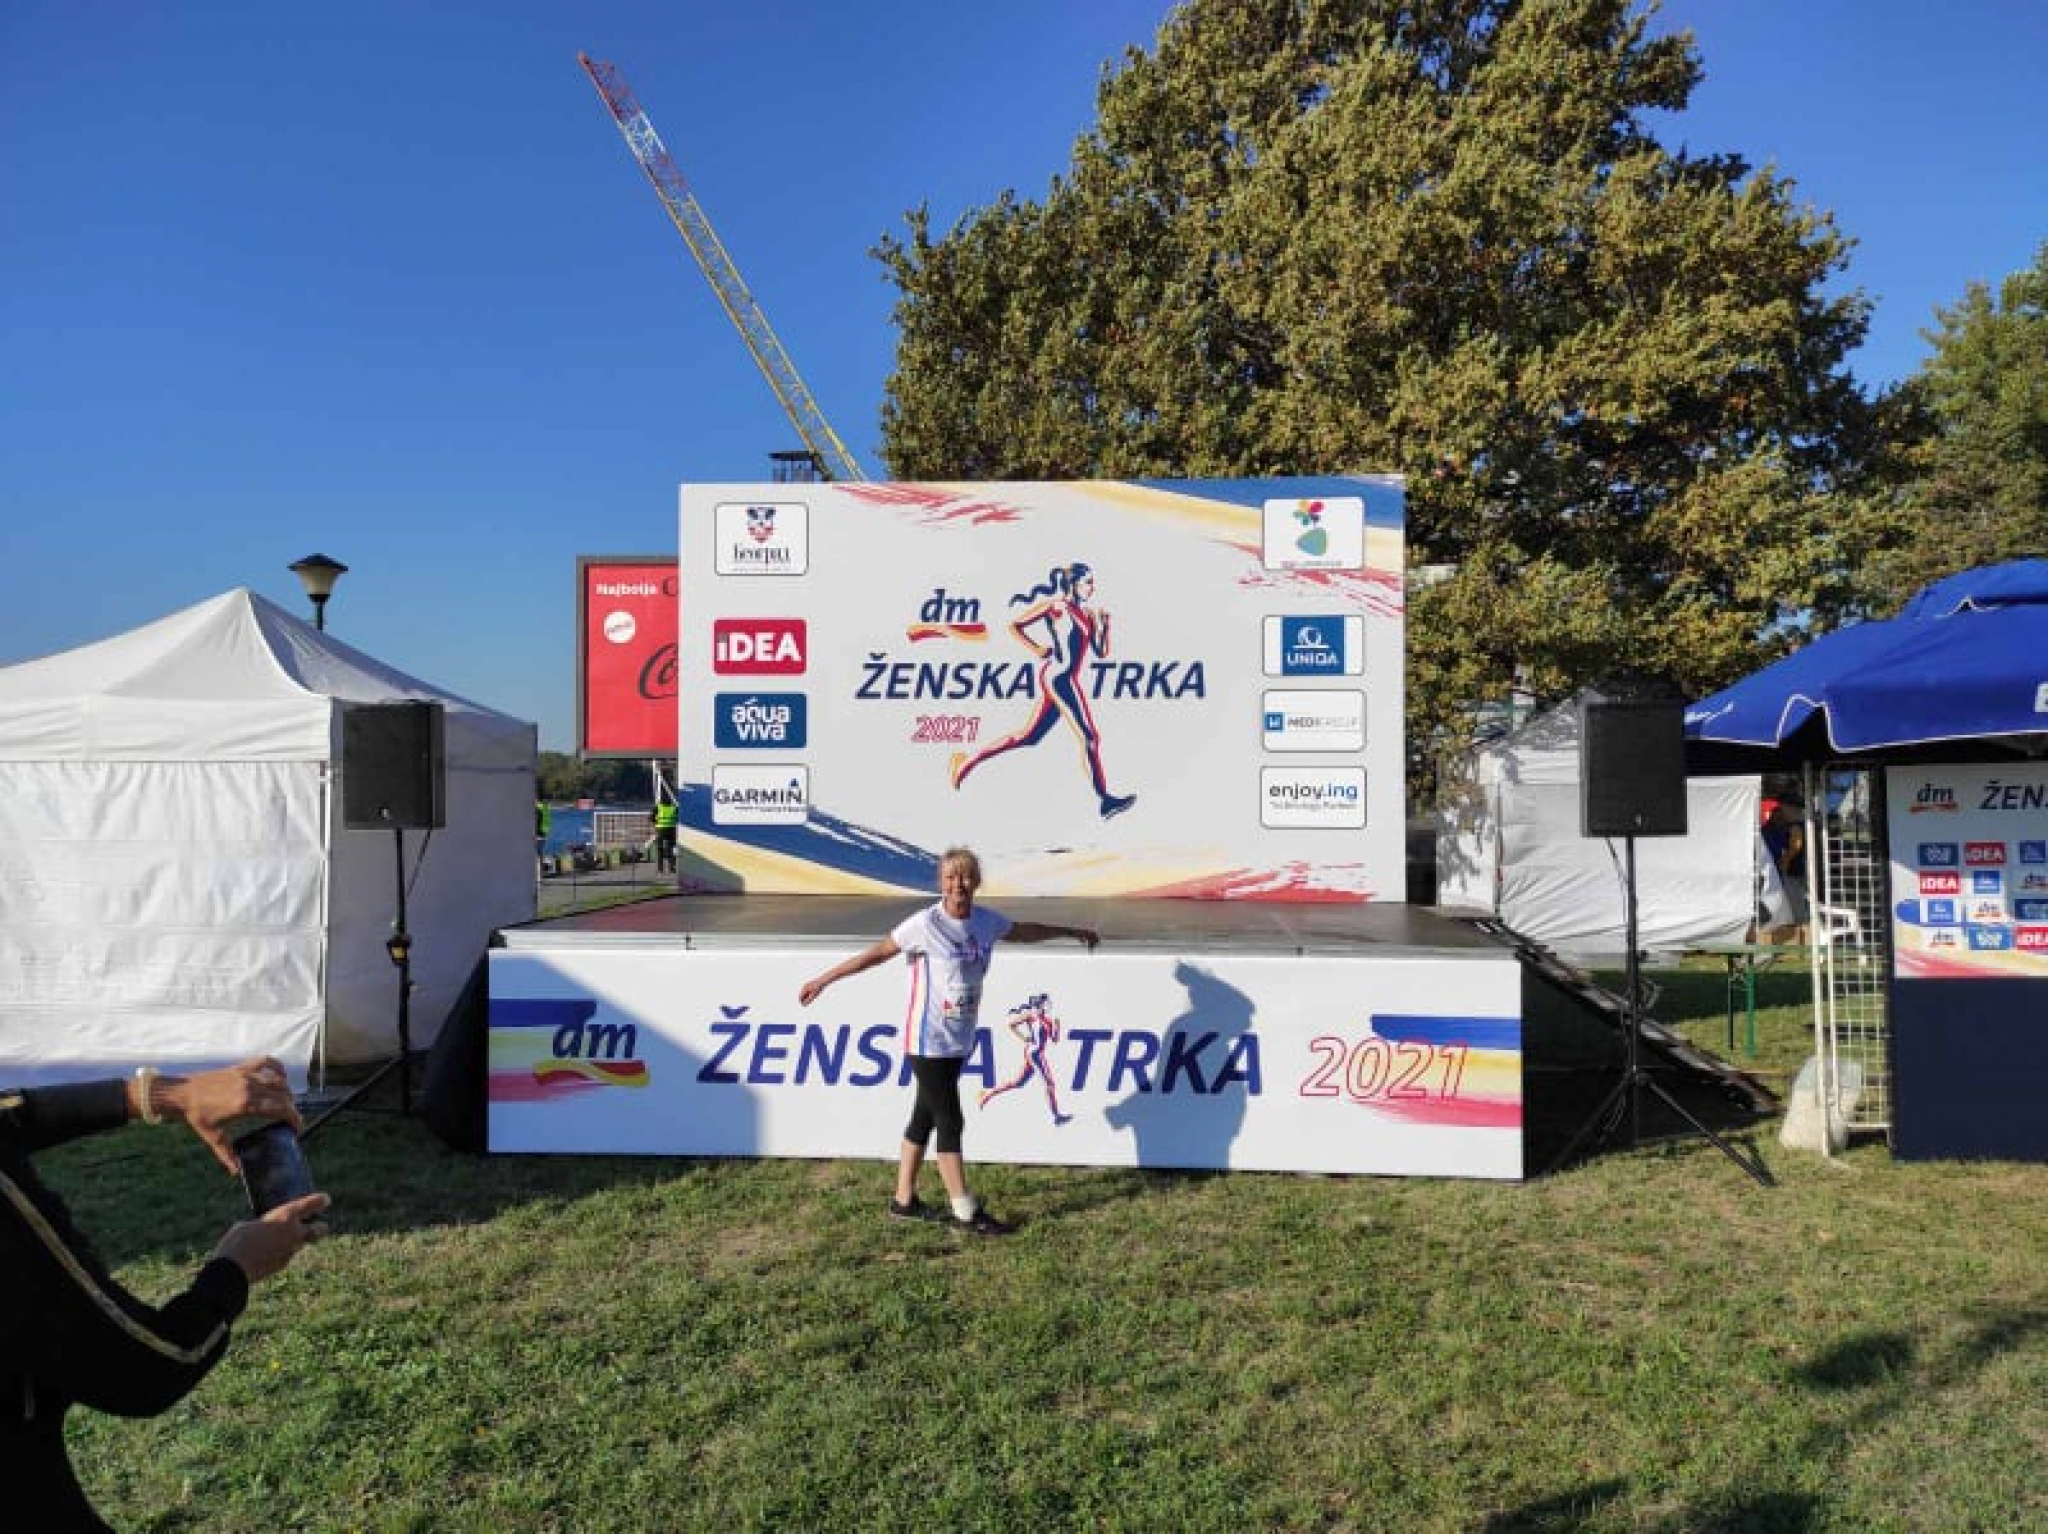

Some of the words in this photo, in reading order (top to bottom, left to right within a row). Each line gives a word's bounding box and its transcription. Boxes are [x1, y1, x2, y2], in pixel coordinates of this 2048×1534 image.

[920, 588, 980, 623] dm
[716, 631, 802, 662] iDEA
[855, 652, 1035, 699] ŽENSKA
[1090, 661, 1206, 699] TRKA
[737, 723, 787, 740] viva
[911, 715, 981, 744] 2021
[714, 787, 802, 804] GARMIN
[1269, 783, 1358, 801] enjoy.ing
[1979, 780, 2048, 810] ŽEN
[552, 1001, 637, 1058] dm
[696, 1005, 996, 1089] ŽENSA
[1067, 1029, 1262, 1096] TRKA
[1300, 1036, 1469, 1101] 2021
